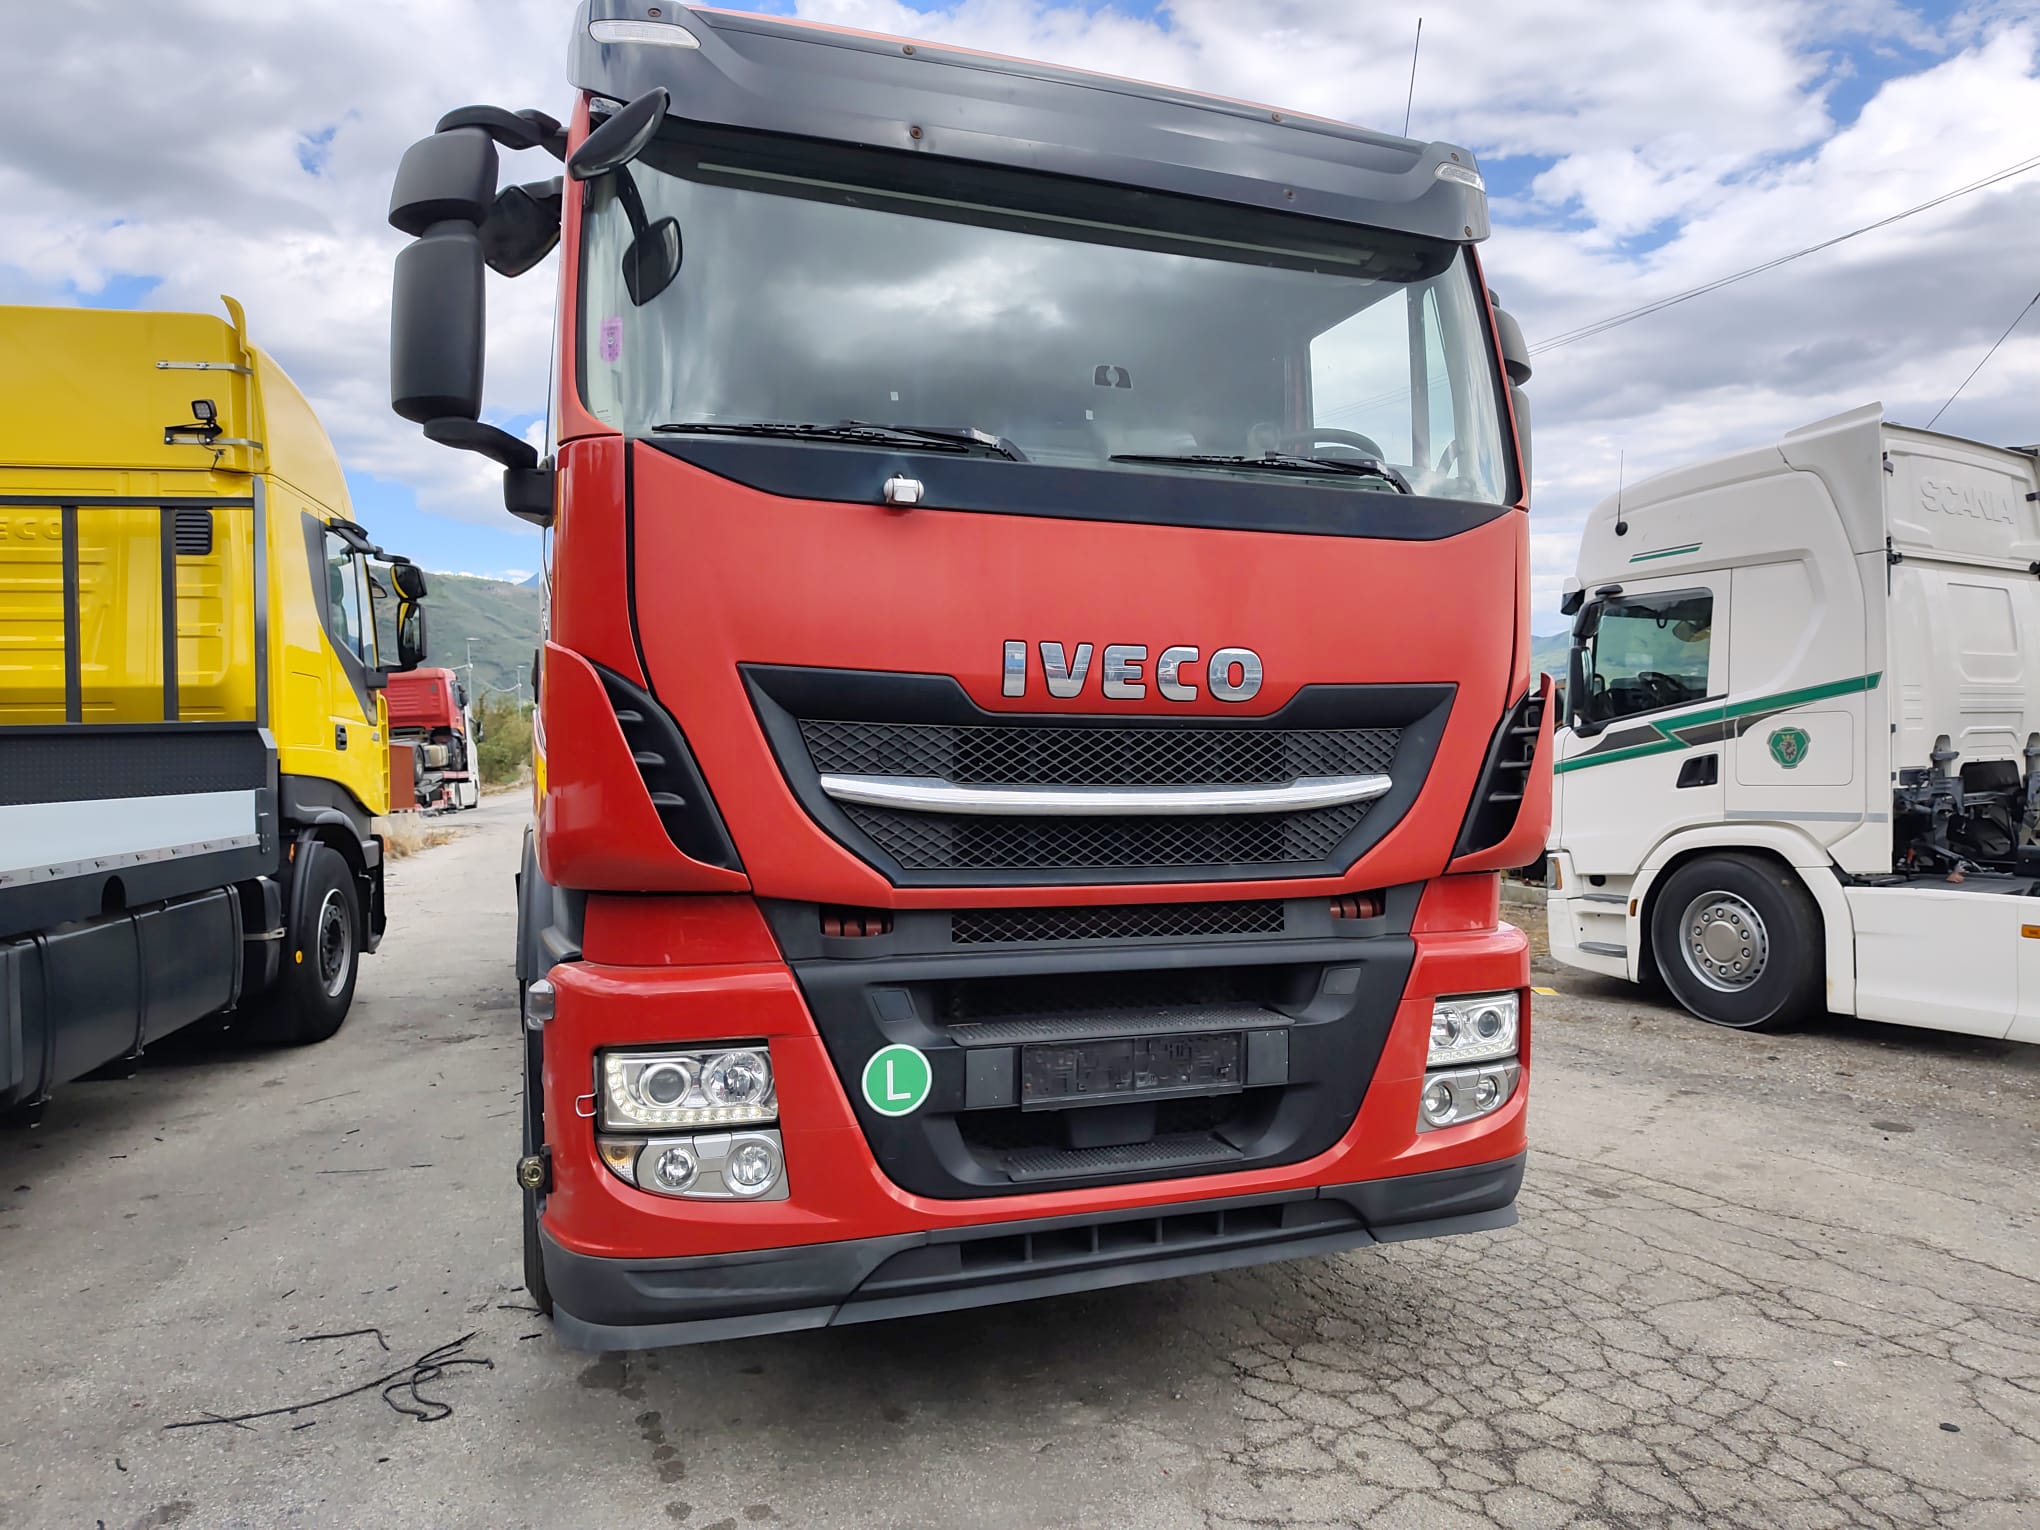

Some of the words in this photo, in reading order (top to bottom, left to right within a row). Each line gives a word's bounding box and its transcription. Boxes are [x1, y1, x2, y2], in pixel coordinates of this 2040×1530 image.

[1919, 476, 2015, 525] SCANIA
[1002, 640, 1264, 702] IVECO
[886, 1059, 912, 1101] L
